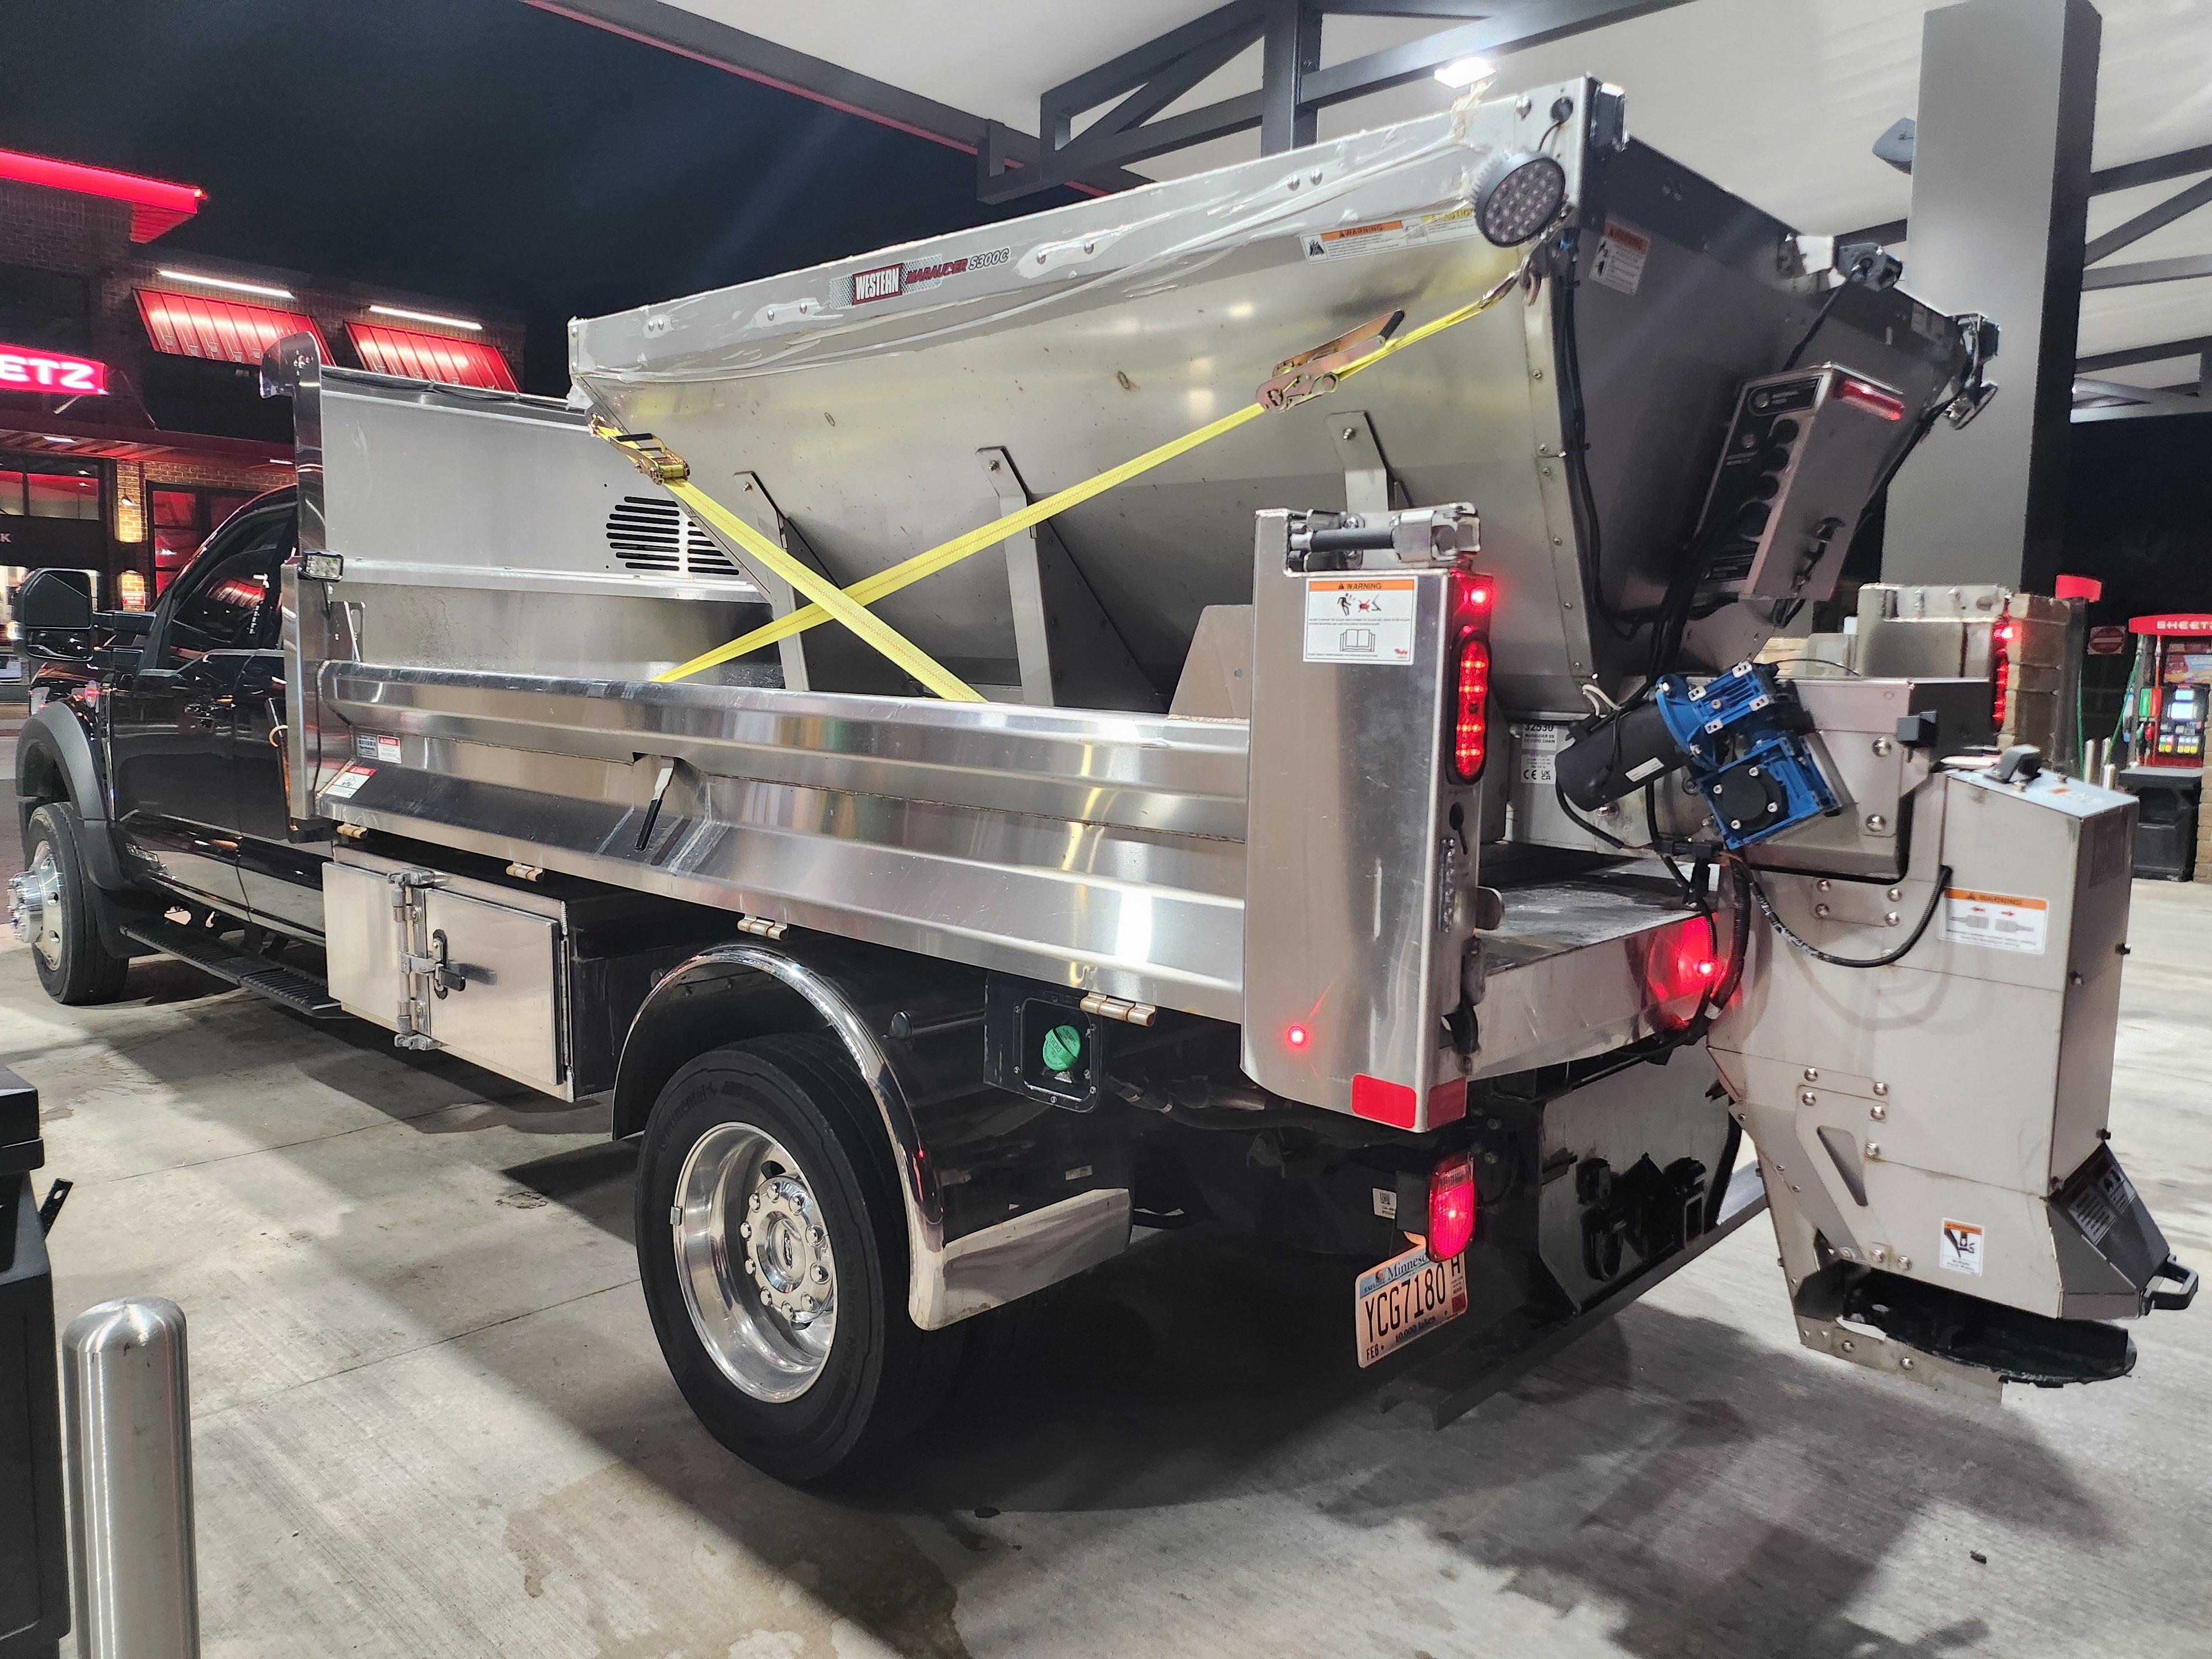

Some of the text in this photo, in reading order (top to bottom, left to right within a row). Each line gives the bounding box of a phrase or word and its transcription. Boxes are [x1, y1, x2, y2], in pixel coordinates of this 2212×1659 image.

[906, 247, 1009, 284] MARAUDER S300C
[855, 267, 899, 301] WESTERN
[0, 354, 95, 389] ETZ
[2157, 620, 2212, 630] SHEET
[1524, 769, 1537, 780] CE
[1050, 1035, 1062, 1053] DIESEL
[1387, 1253, 1430, 1281] Minneso
[1365, 1262, 1446, 1343] YCG7180
[1366, 1343, 1379, 1361] FEB
